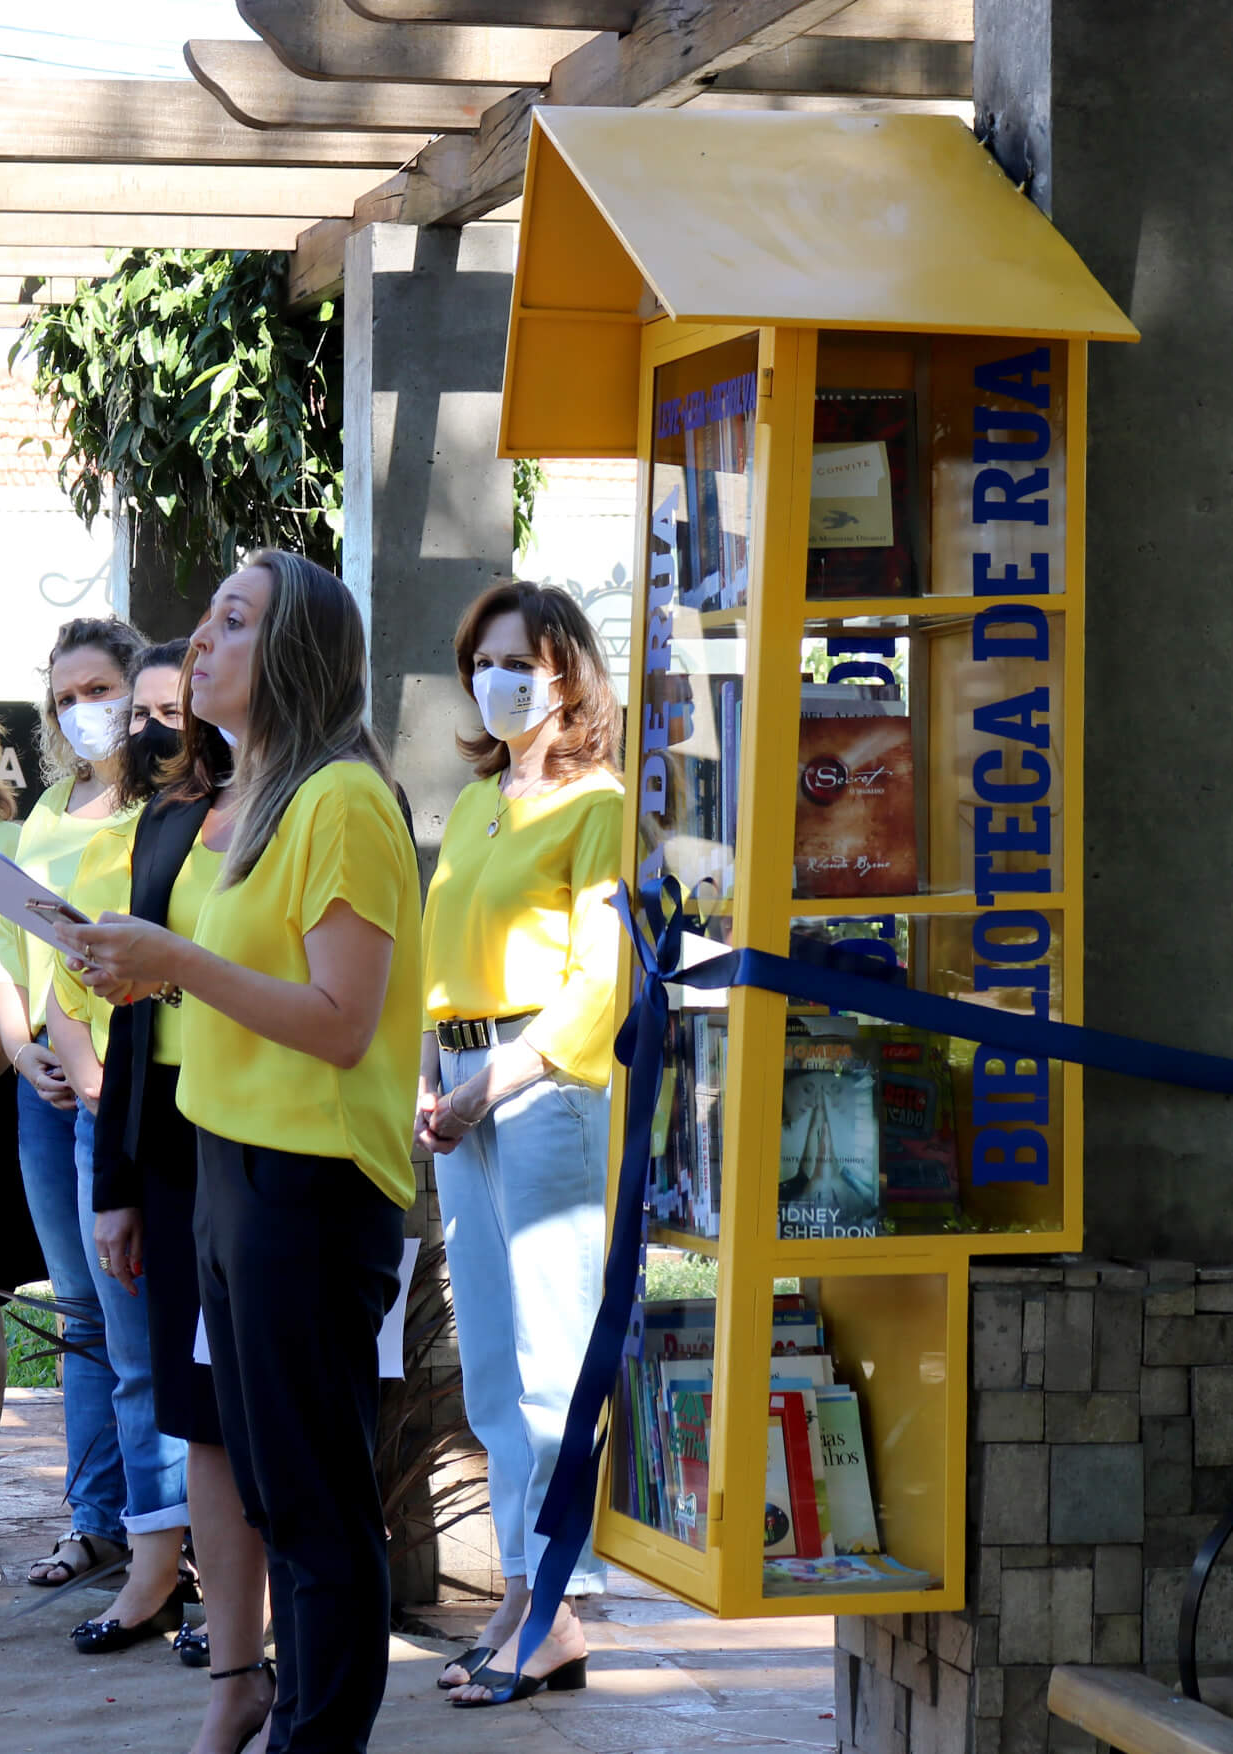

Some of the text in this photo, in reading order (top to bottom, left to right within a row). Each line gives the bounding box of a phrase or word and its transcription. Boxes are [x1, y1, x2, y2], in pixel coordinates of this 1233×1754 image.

[816, 459, 872, 477] CONVITE
[972, 346, 1051, 527] RUA
[646, 483, 680, 675] RUA
[972, 552, 1050, 662] DE
[814, 765, 894, 788] Secret
[783, 1225, 876, 1239] SHELDON
